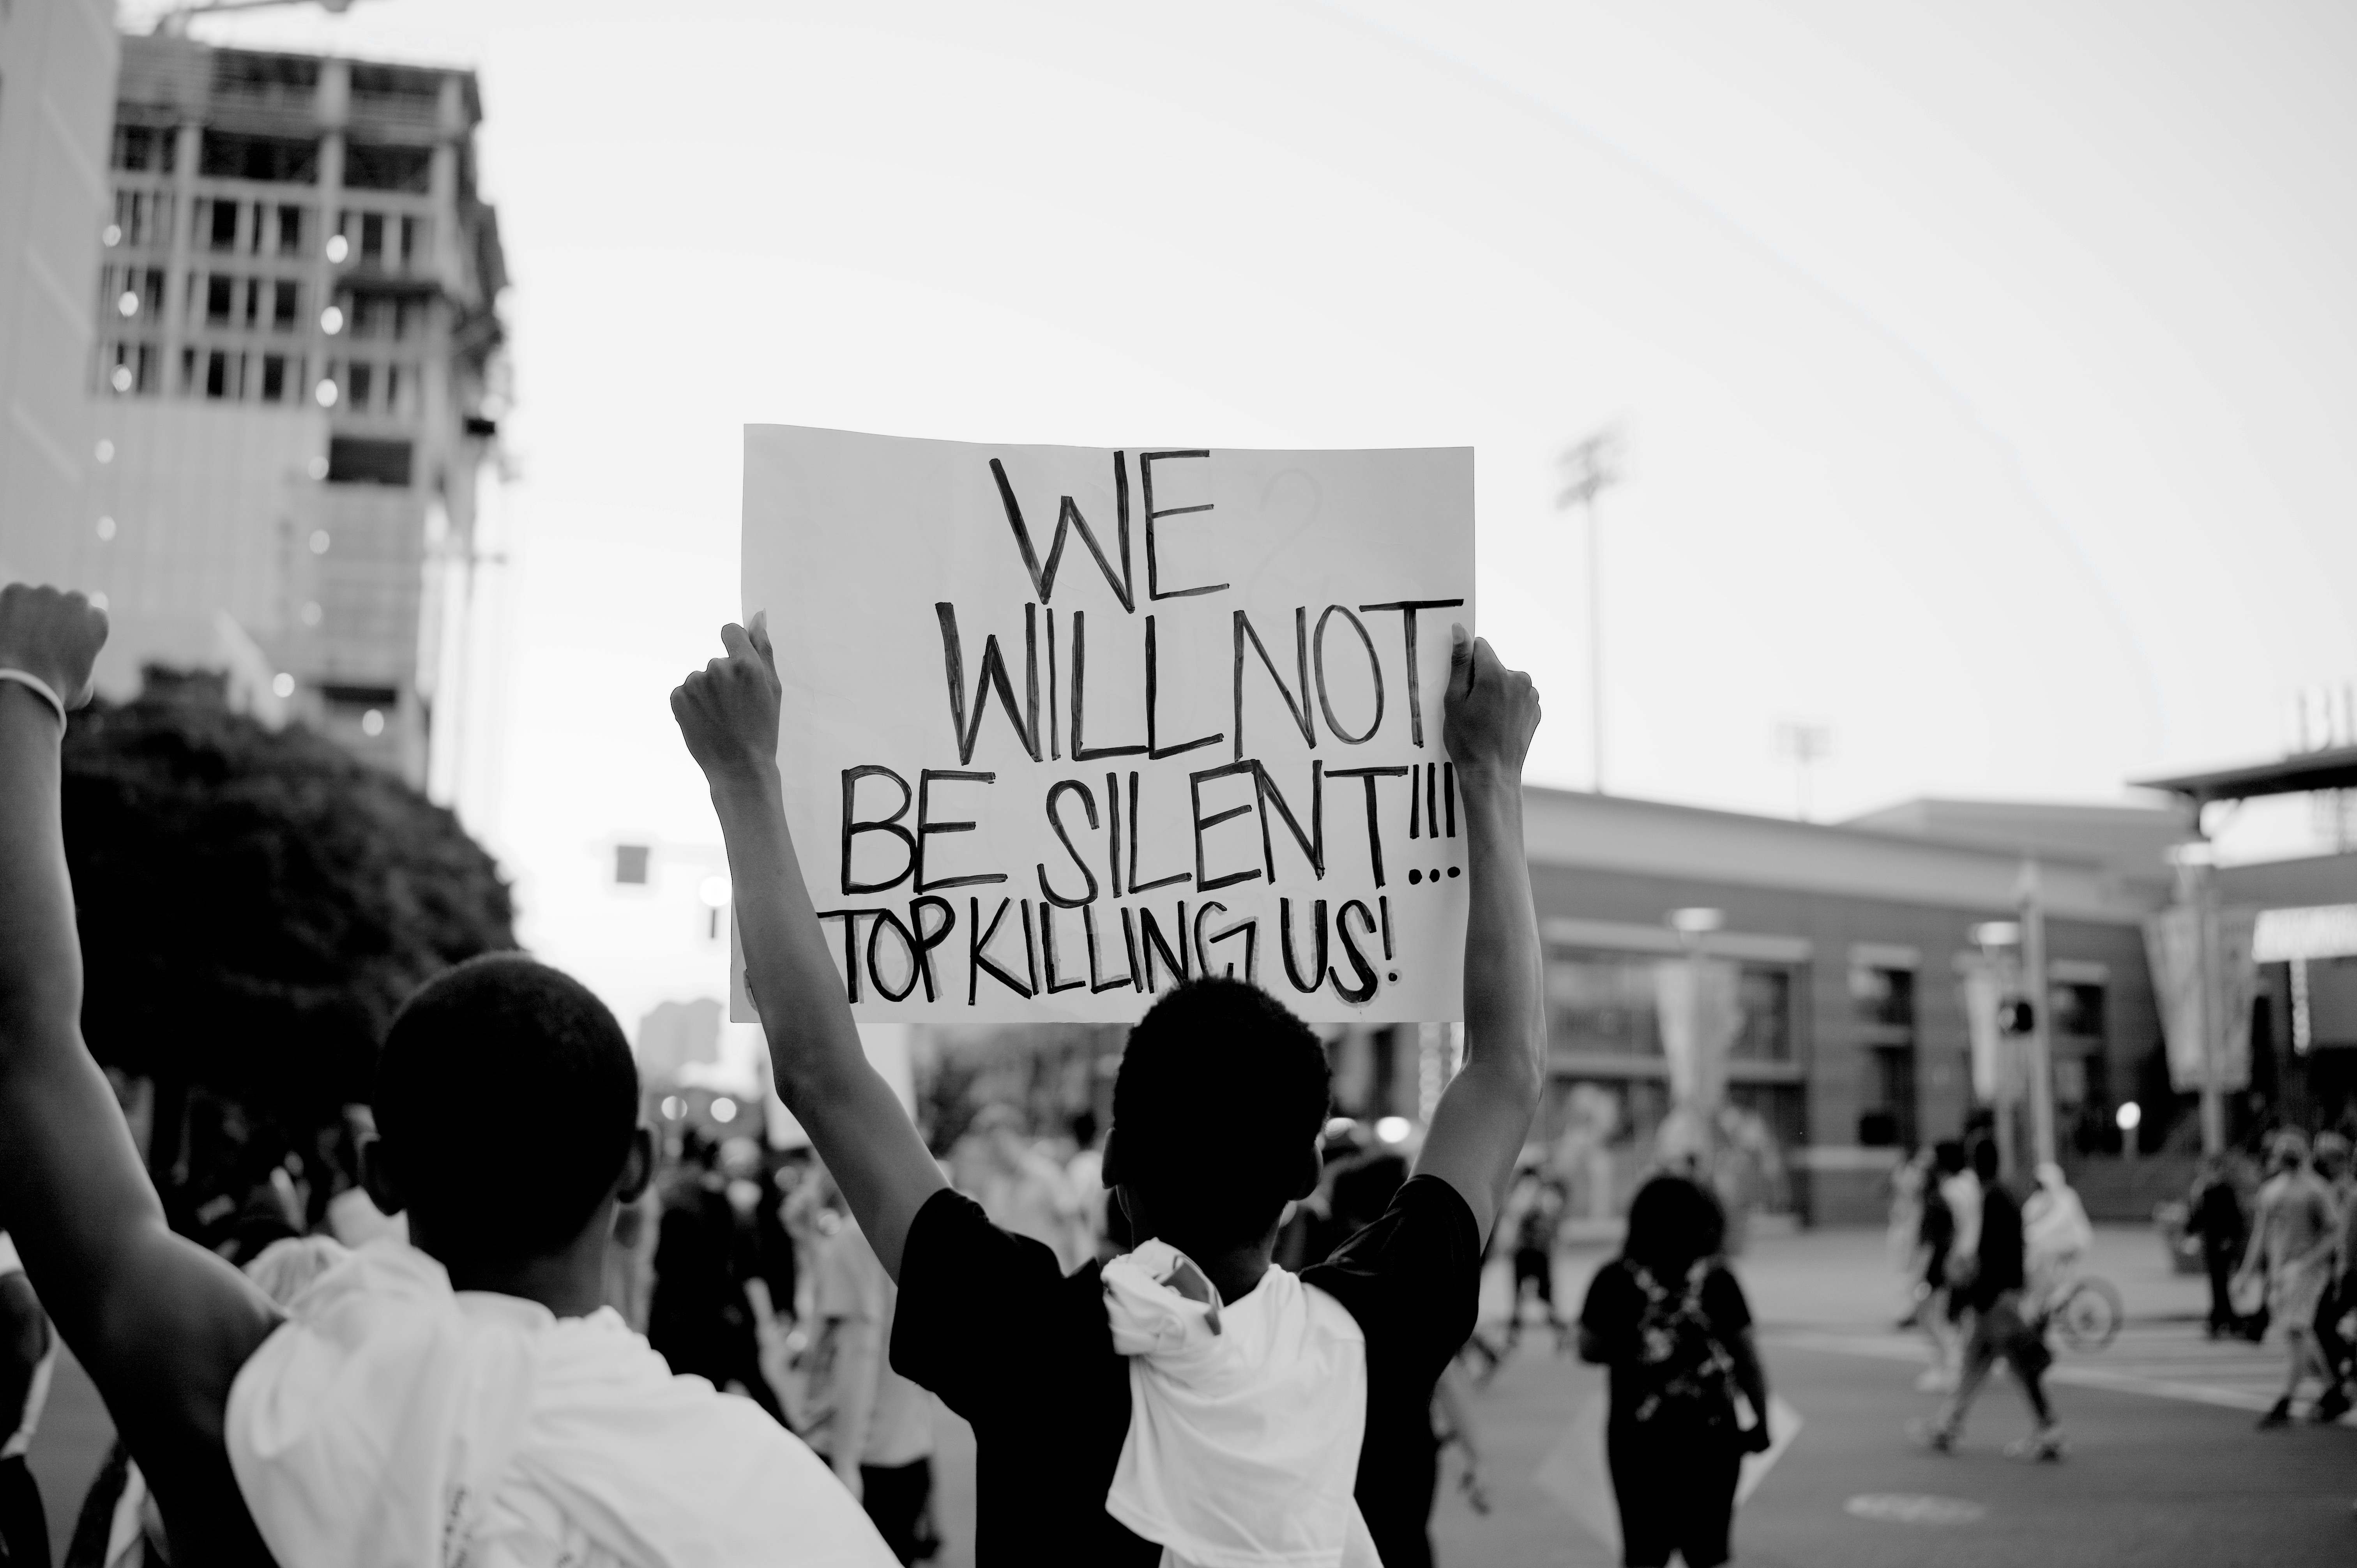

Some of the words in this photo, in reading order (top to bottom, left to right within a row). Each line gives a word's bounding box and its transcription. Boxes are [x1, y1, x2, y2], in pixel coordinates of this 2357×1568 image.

[989, 450, 1230, 614] WE
[935, 602, 1224, 766] WILL
[1233, 599, 1464, 762] NOT
[841, 765, 1008, 896] BE
[1037, 759, 1461, 909] SILENT!!!
[743, 895, 956, 1013] TOP
[968, 896, 1260, 1006] KILLING
[1279, 895, 1401, 1006] US!
